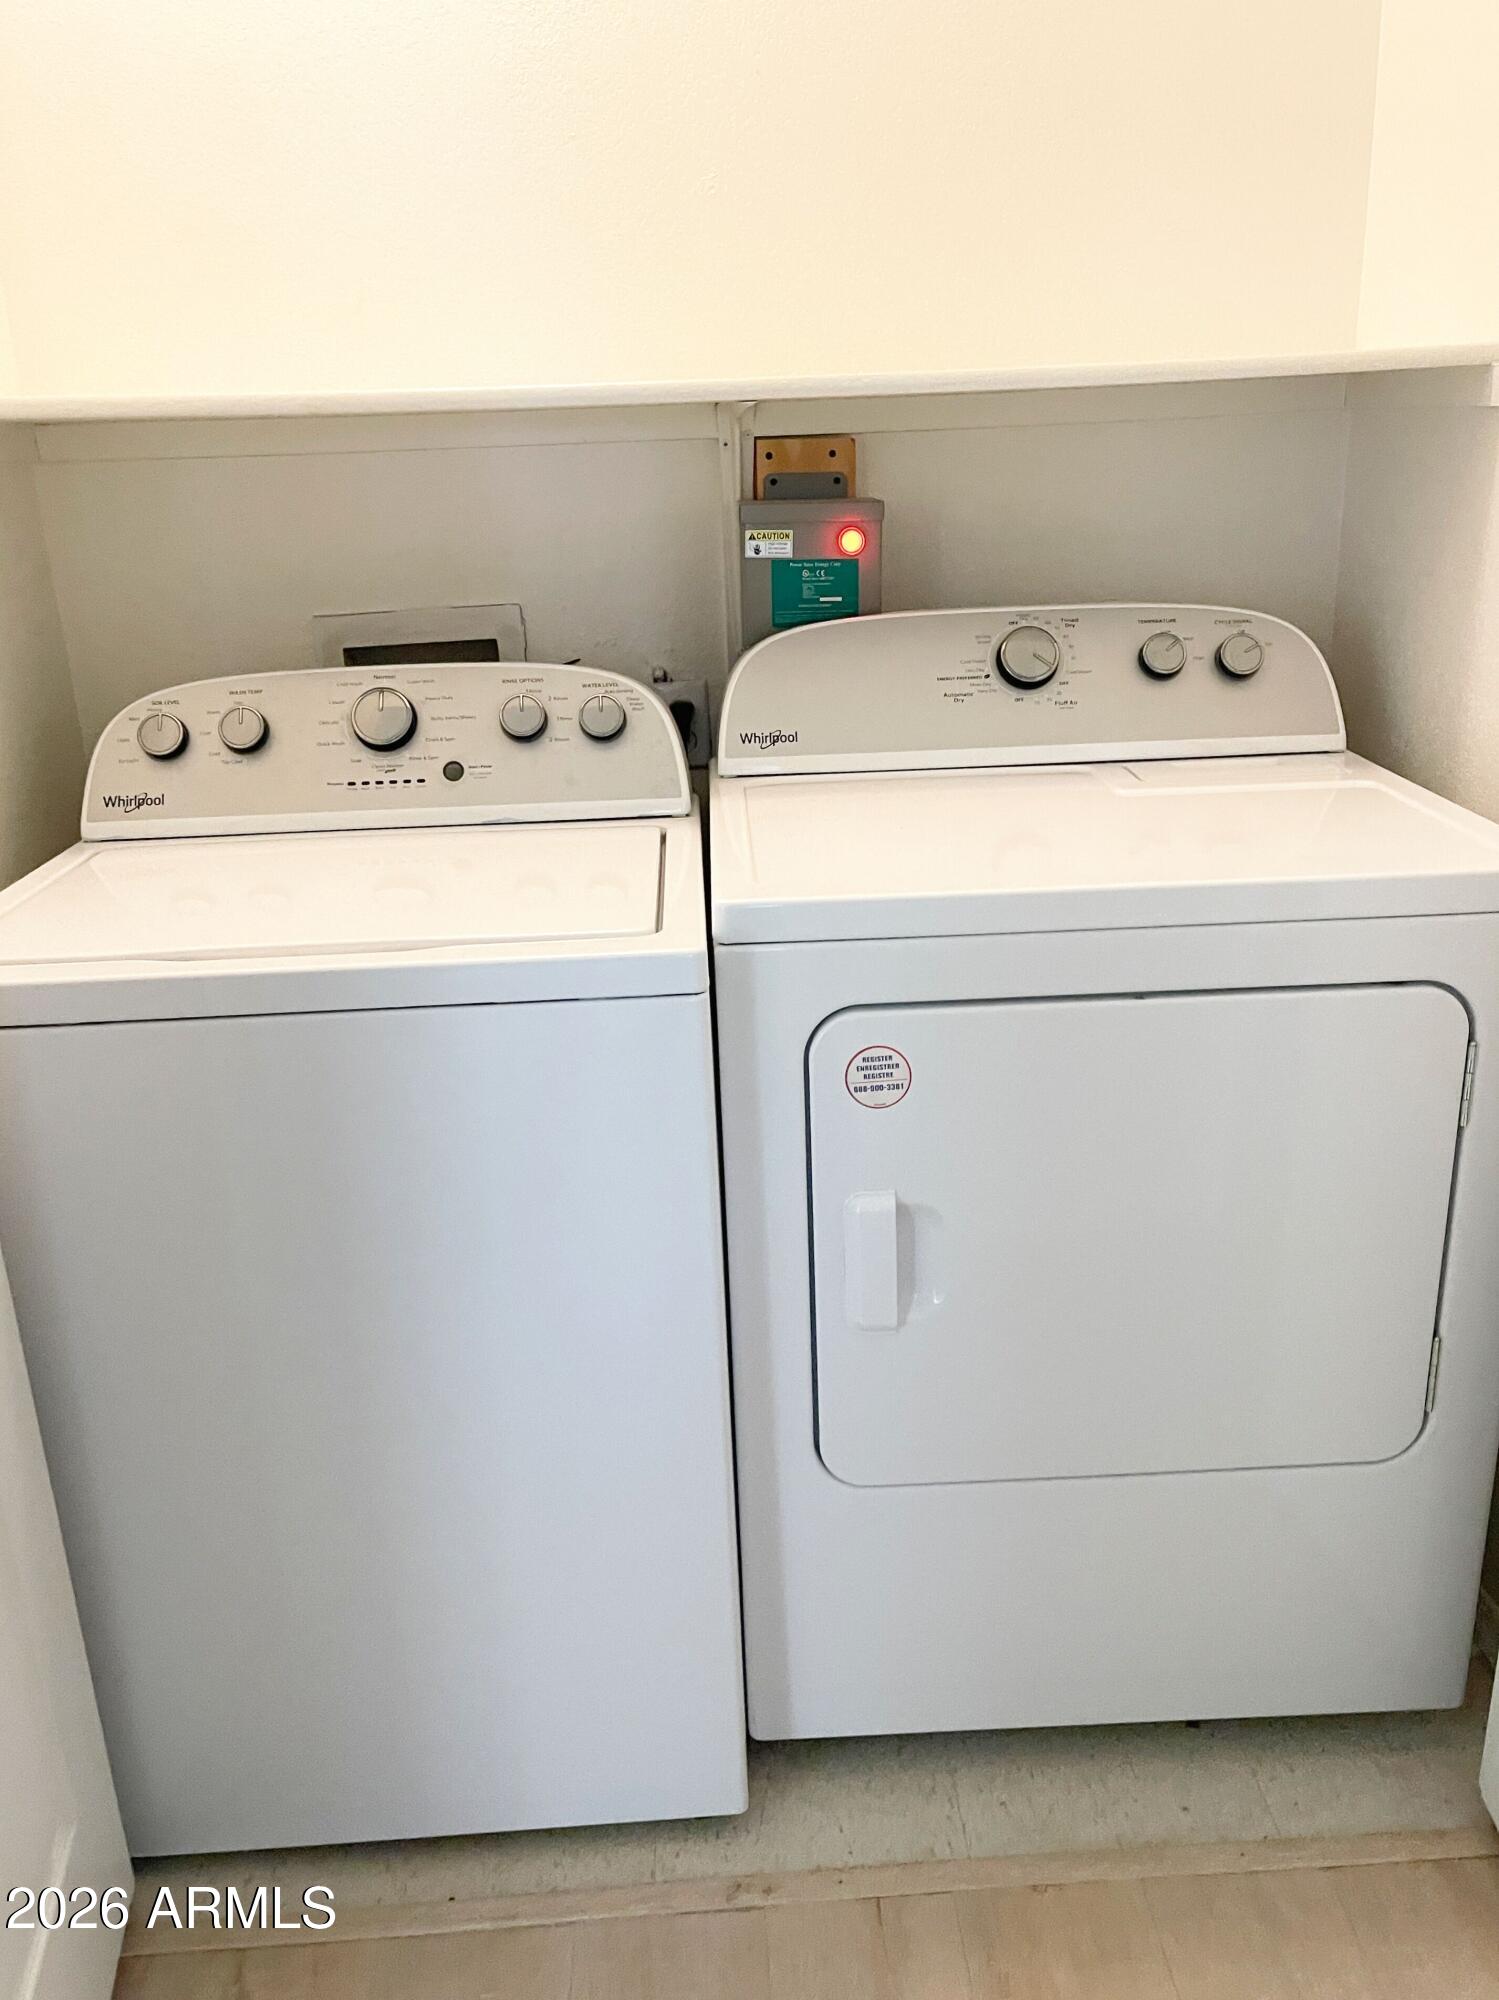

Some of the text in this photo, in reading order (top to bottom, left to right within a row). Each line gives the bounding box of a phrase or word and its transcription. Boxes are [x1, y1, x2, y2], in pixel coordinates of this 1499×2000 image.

[756, 532, 790, 540] CAUTION
[740, 729, 798, 750] Whirlpool
[102, 793, 165, 813] Whirlpool
[862, 1055, 893, 1063] REGISTER
[856, 1063, 900, 1072] ENREGISTRER
[863, 1072, 893, 1080] REGISTRE
